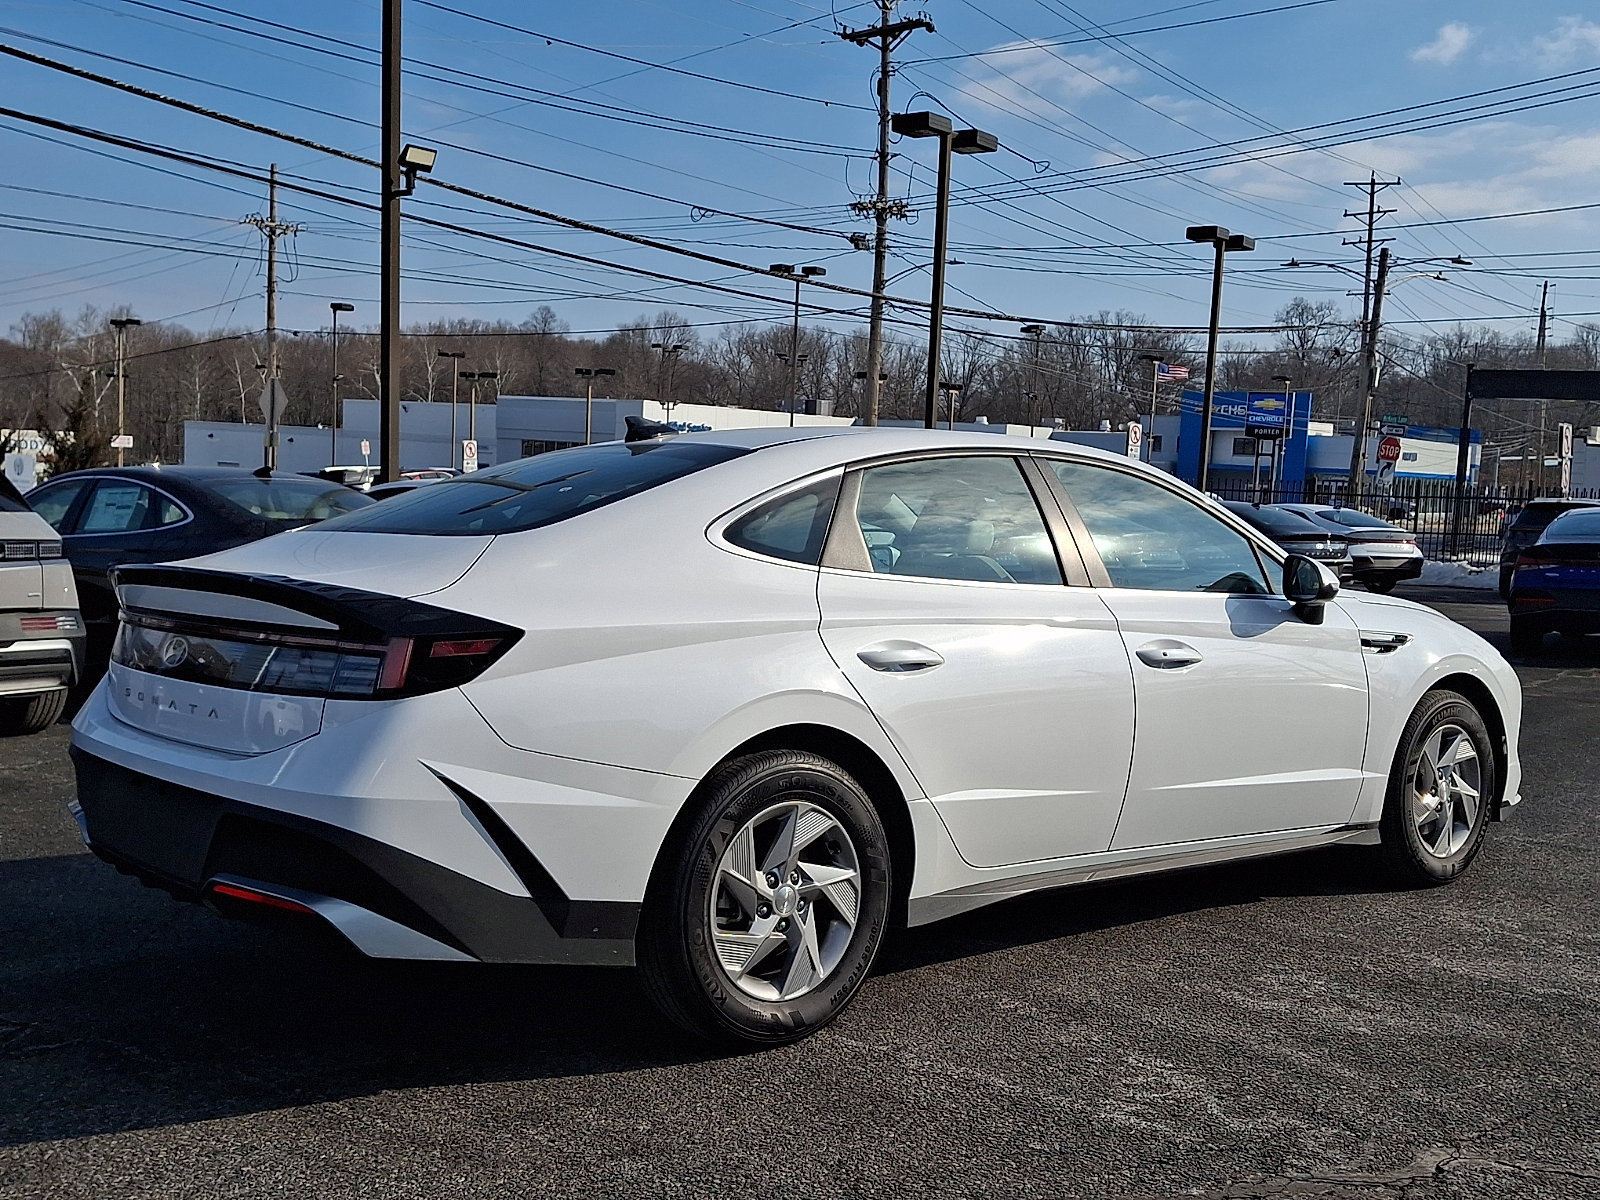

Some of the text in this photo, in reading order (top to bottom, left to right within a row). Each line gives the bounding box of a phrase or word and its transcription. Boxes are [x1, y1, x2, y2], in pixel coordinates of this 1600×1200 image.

[1248, 415, 1285, 423] CHEVROLE
[1380, 444, 1400, 458] STOP
[124, 687, 219, 719] SONATA
[1432, 707, 1462, 725] KUMHO
[830, 917, 880, 1006] 205/65 R16 95H
